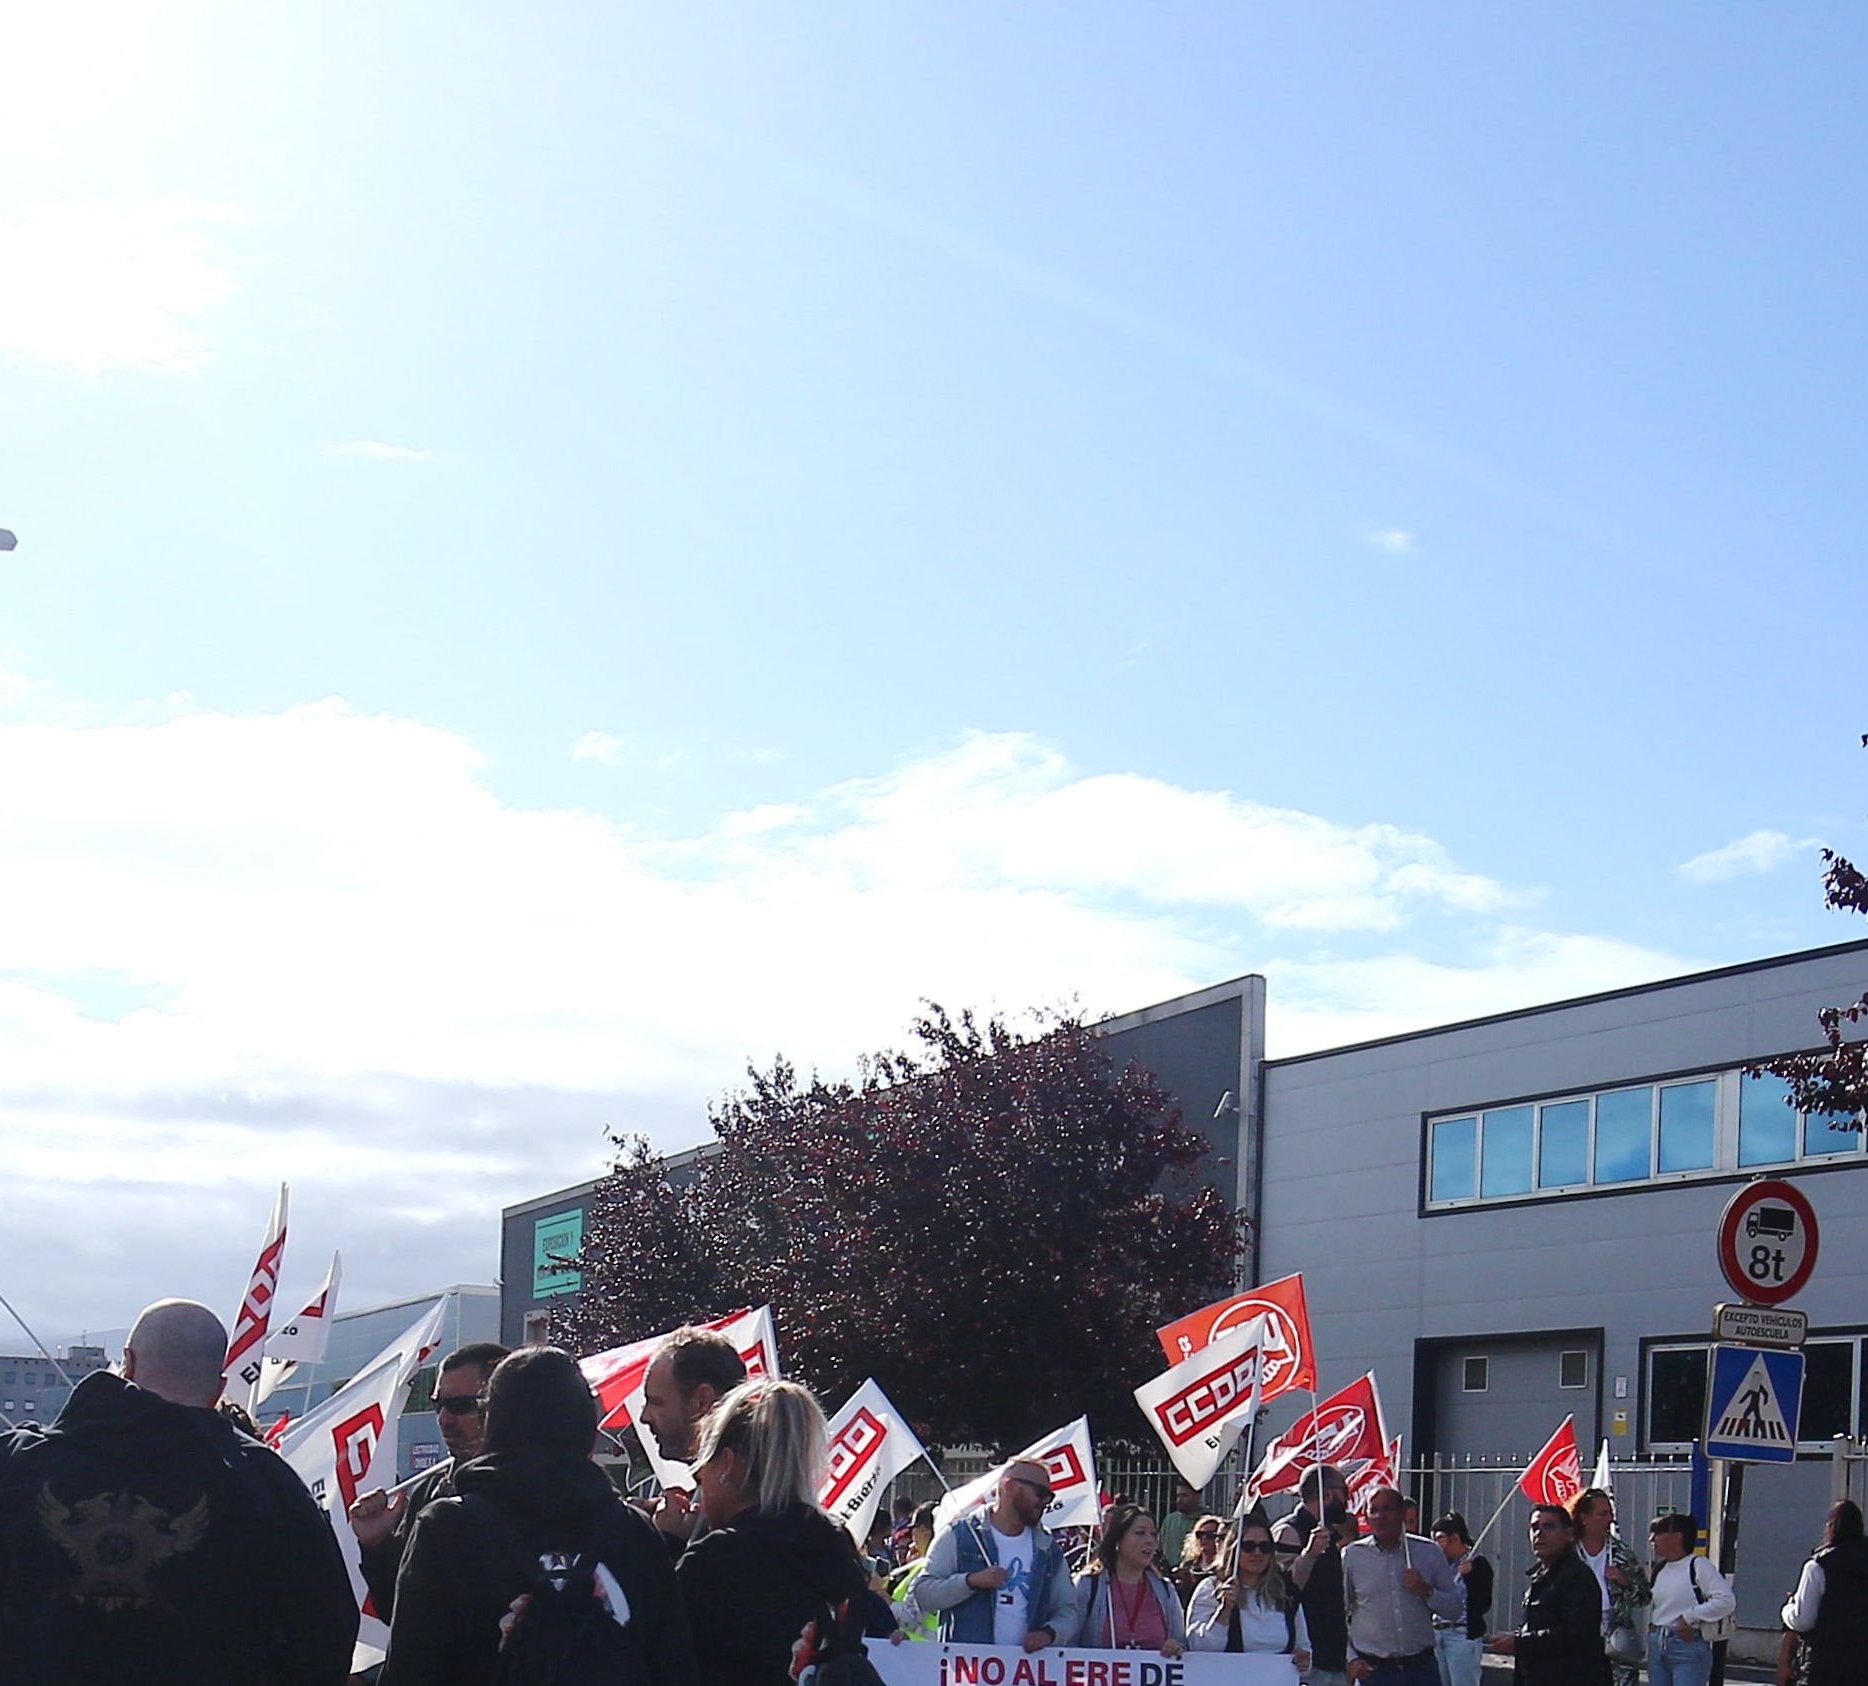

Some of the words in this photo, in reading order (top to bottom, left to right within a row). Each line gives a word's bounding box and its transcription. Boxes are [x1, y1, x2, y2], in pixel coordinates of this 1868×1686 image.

[1749, 1245, 1785, 1281] 8t
[1724, 1311, 1759, 1325] EXCEPTO
[1734, 1325, 1790, 1340] AUTOESCUELA
